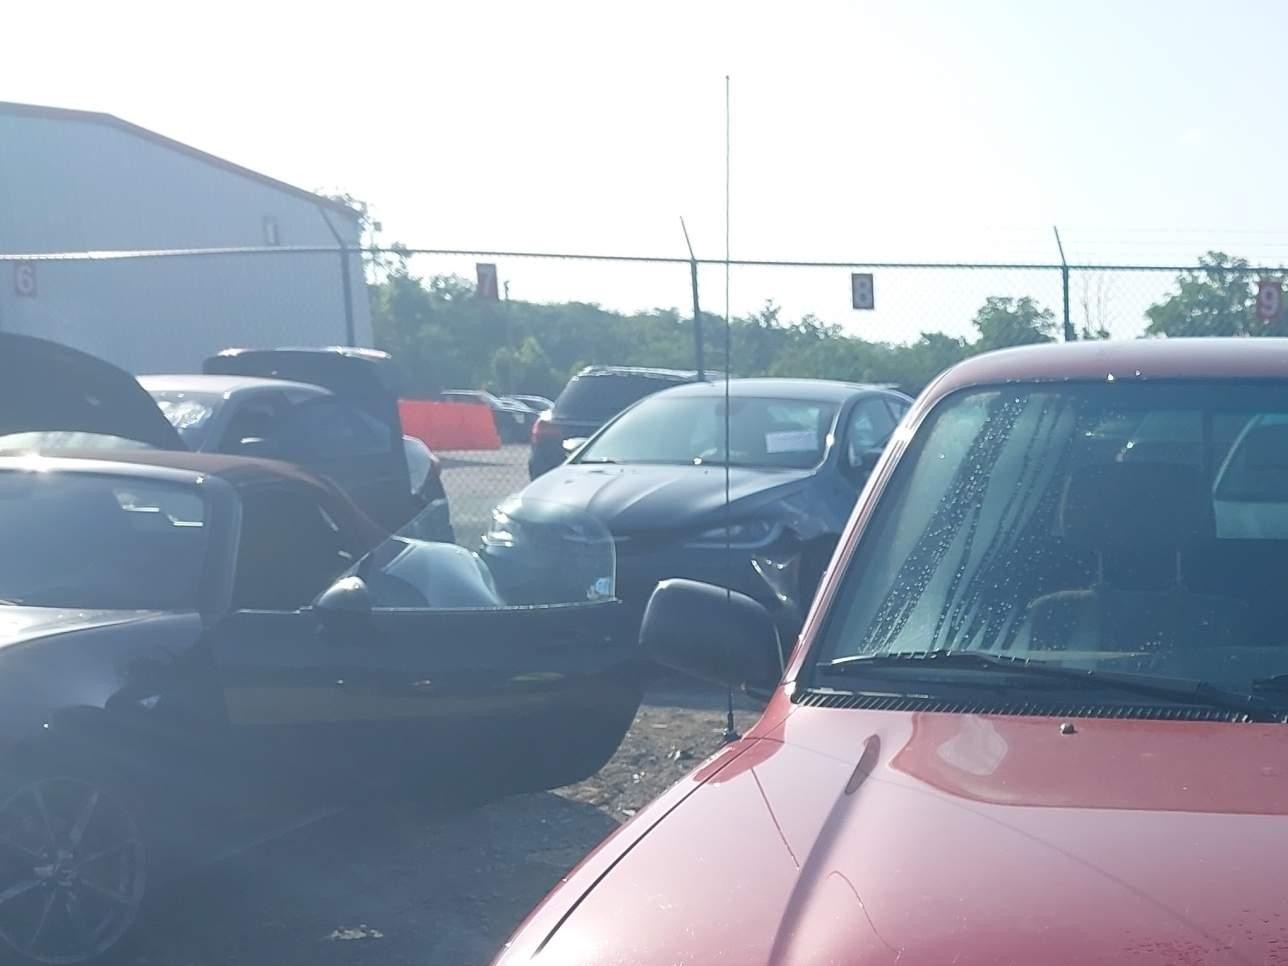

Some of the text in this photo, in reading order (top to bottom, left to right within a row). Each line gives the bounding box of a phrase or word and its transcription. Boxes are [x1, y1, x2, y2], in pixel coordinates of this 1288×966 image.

[16, 264, 34, 294] 6
[478, 266, 495, 296] 7
[854, 277, 873, 307] 8
[1261, 286, 1280, 317] 9
